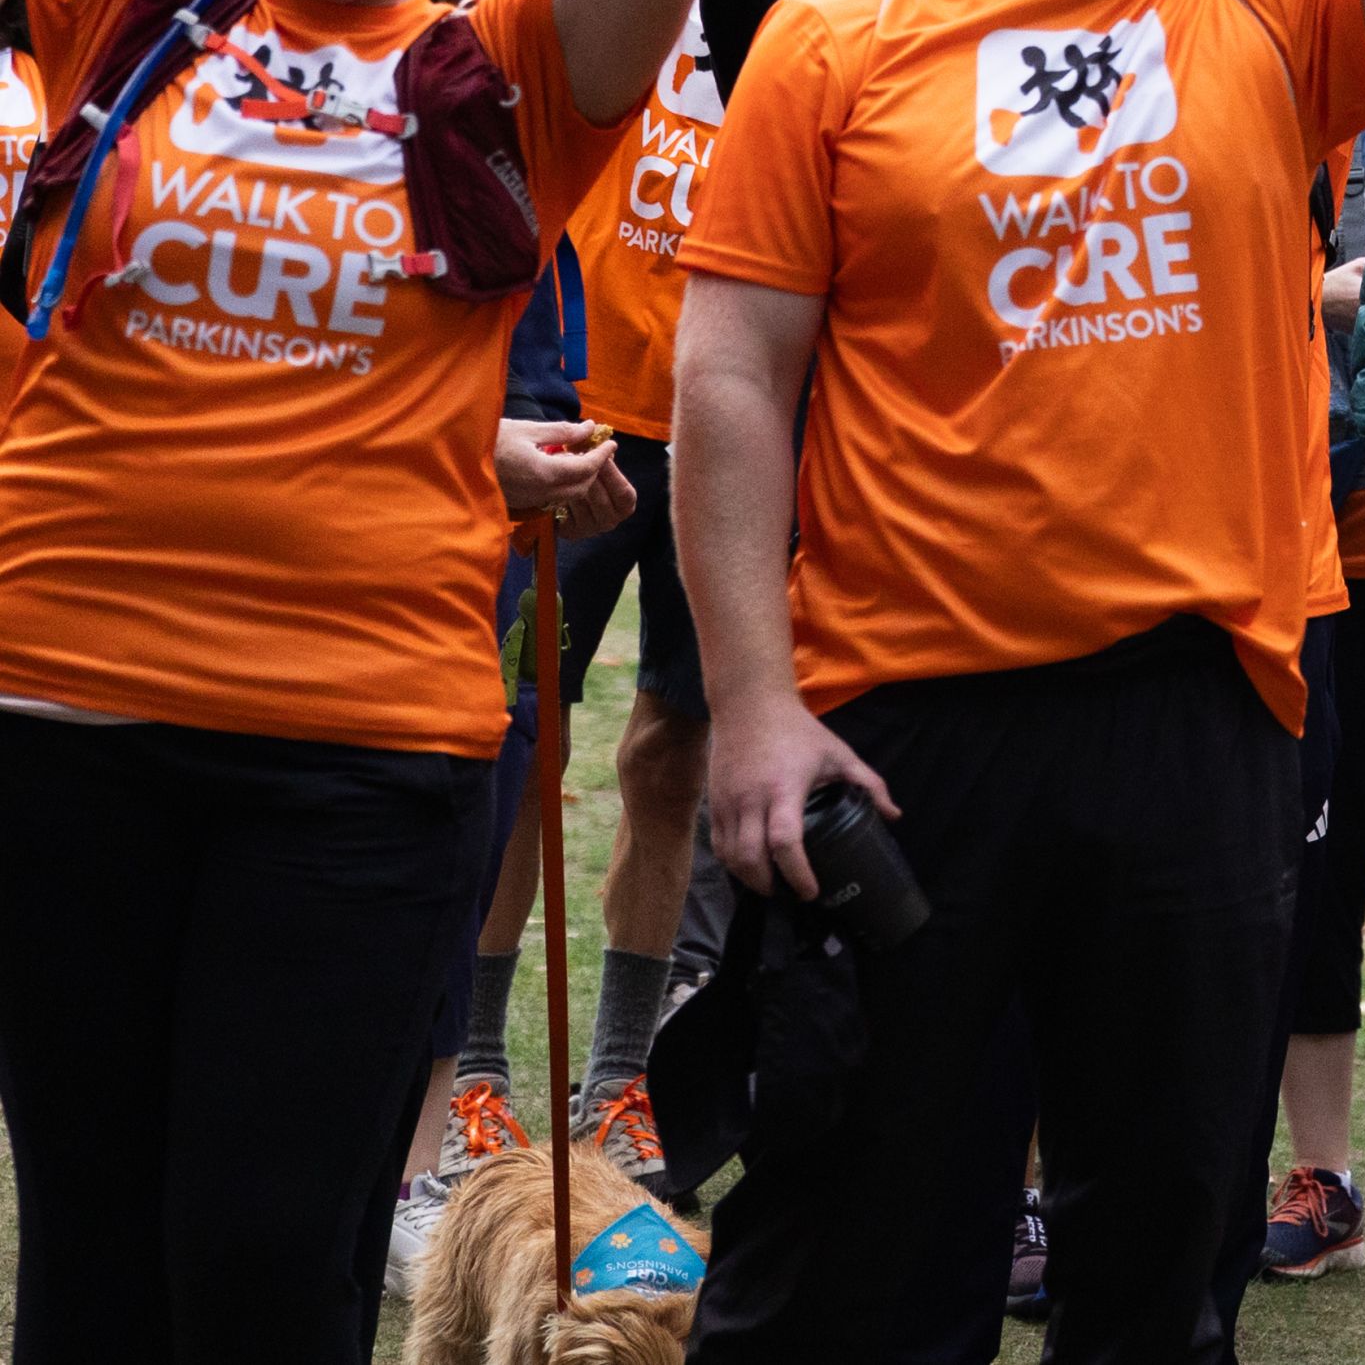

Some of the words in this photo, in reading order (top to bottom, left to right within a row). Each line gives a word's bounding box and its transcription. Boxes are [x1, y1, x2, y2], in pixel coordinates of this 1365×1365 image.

[641, 108, 714, 168] WAL
[151, 161, 317, 235] WALK
[327, 192, 404, 247] TO
[630, 155, 696, 227] CU
[1116, 155, 1189, 210] TO
[130, 220, 389, 337] CURE
[987, 211, 1199, 329] CURE
[125, 309, 374, 375] PARKINSON'S
[605, 1259, 689, 1280] PARKINSON'S
